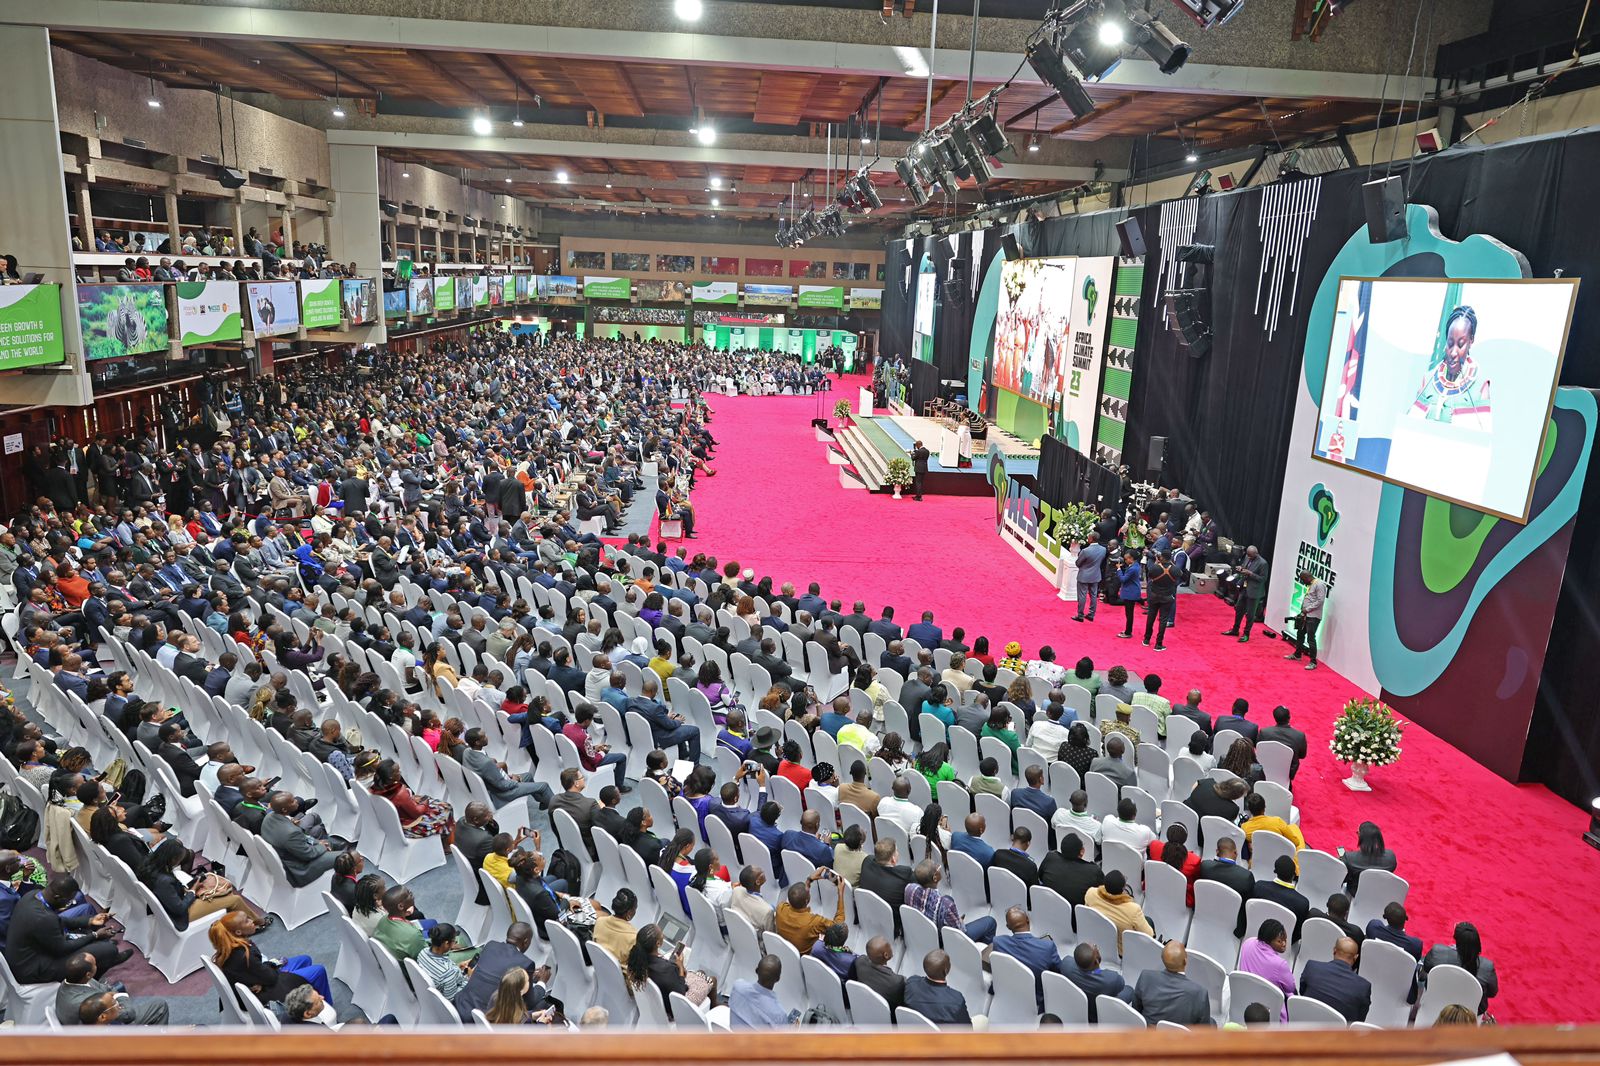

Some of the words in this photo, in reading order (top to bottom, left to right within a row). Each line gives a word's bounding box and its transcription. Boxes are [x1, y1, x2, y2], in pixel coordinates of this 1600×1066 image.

[14, 321, 37, 331] GROWTH
[12, 334, 42, 344] SOLUTIONS
[43, 332, 53, 341] FOR
[1075, 331, 1092, 345] AFRICA
[11, 348, 22, 358] THE
[23, 346, 43, 356] WORLD
[1074, 344, 1094, 358] CLIMATE
[1072, 355, 1091, 371] SUMMIT
[1070, 370, 1081, 391] 23
[1299, 540, 1332, 568] AFRICA
[1296, 554, 1337, 587] CLIMATE
